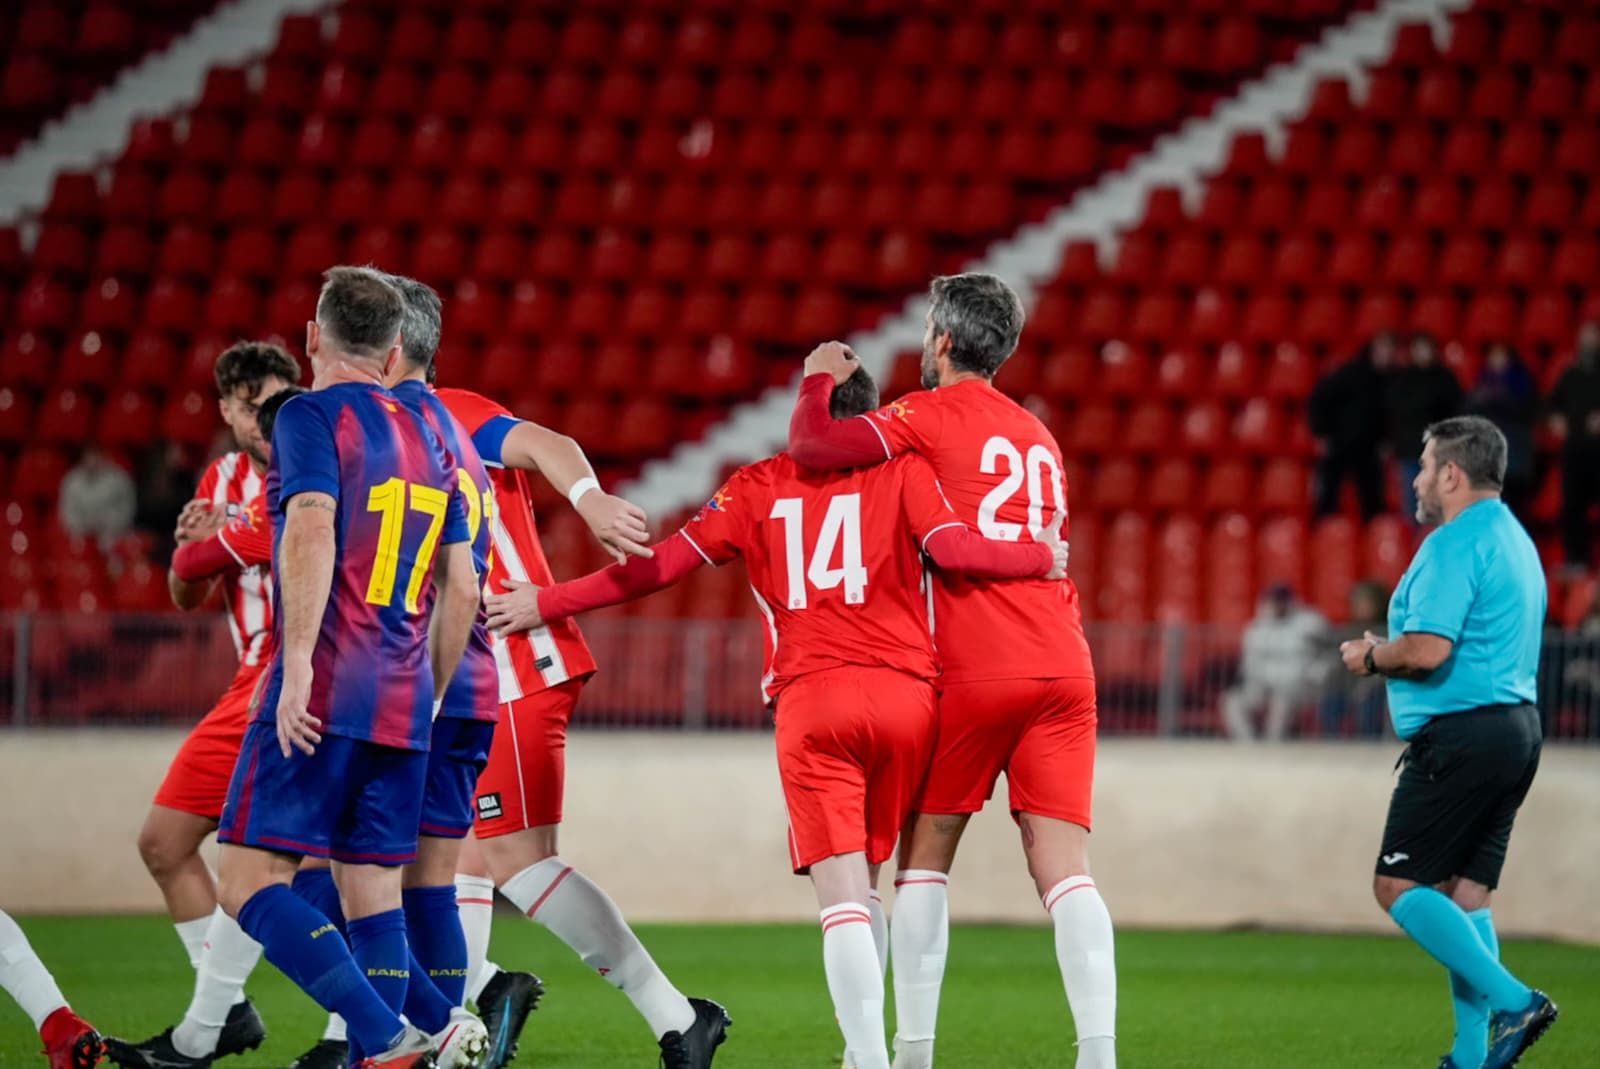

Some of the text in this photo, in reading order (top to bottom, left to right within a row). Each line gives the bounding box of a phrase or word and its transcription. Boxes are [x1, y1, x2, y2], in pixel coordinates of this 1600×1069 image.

[366, 477, 448, 615] 17
[977, 436, 1067, 541] 20
[769, 493, 868, 609] 14
